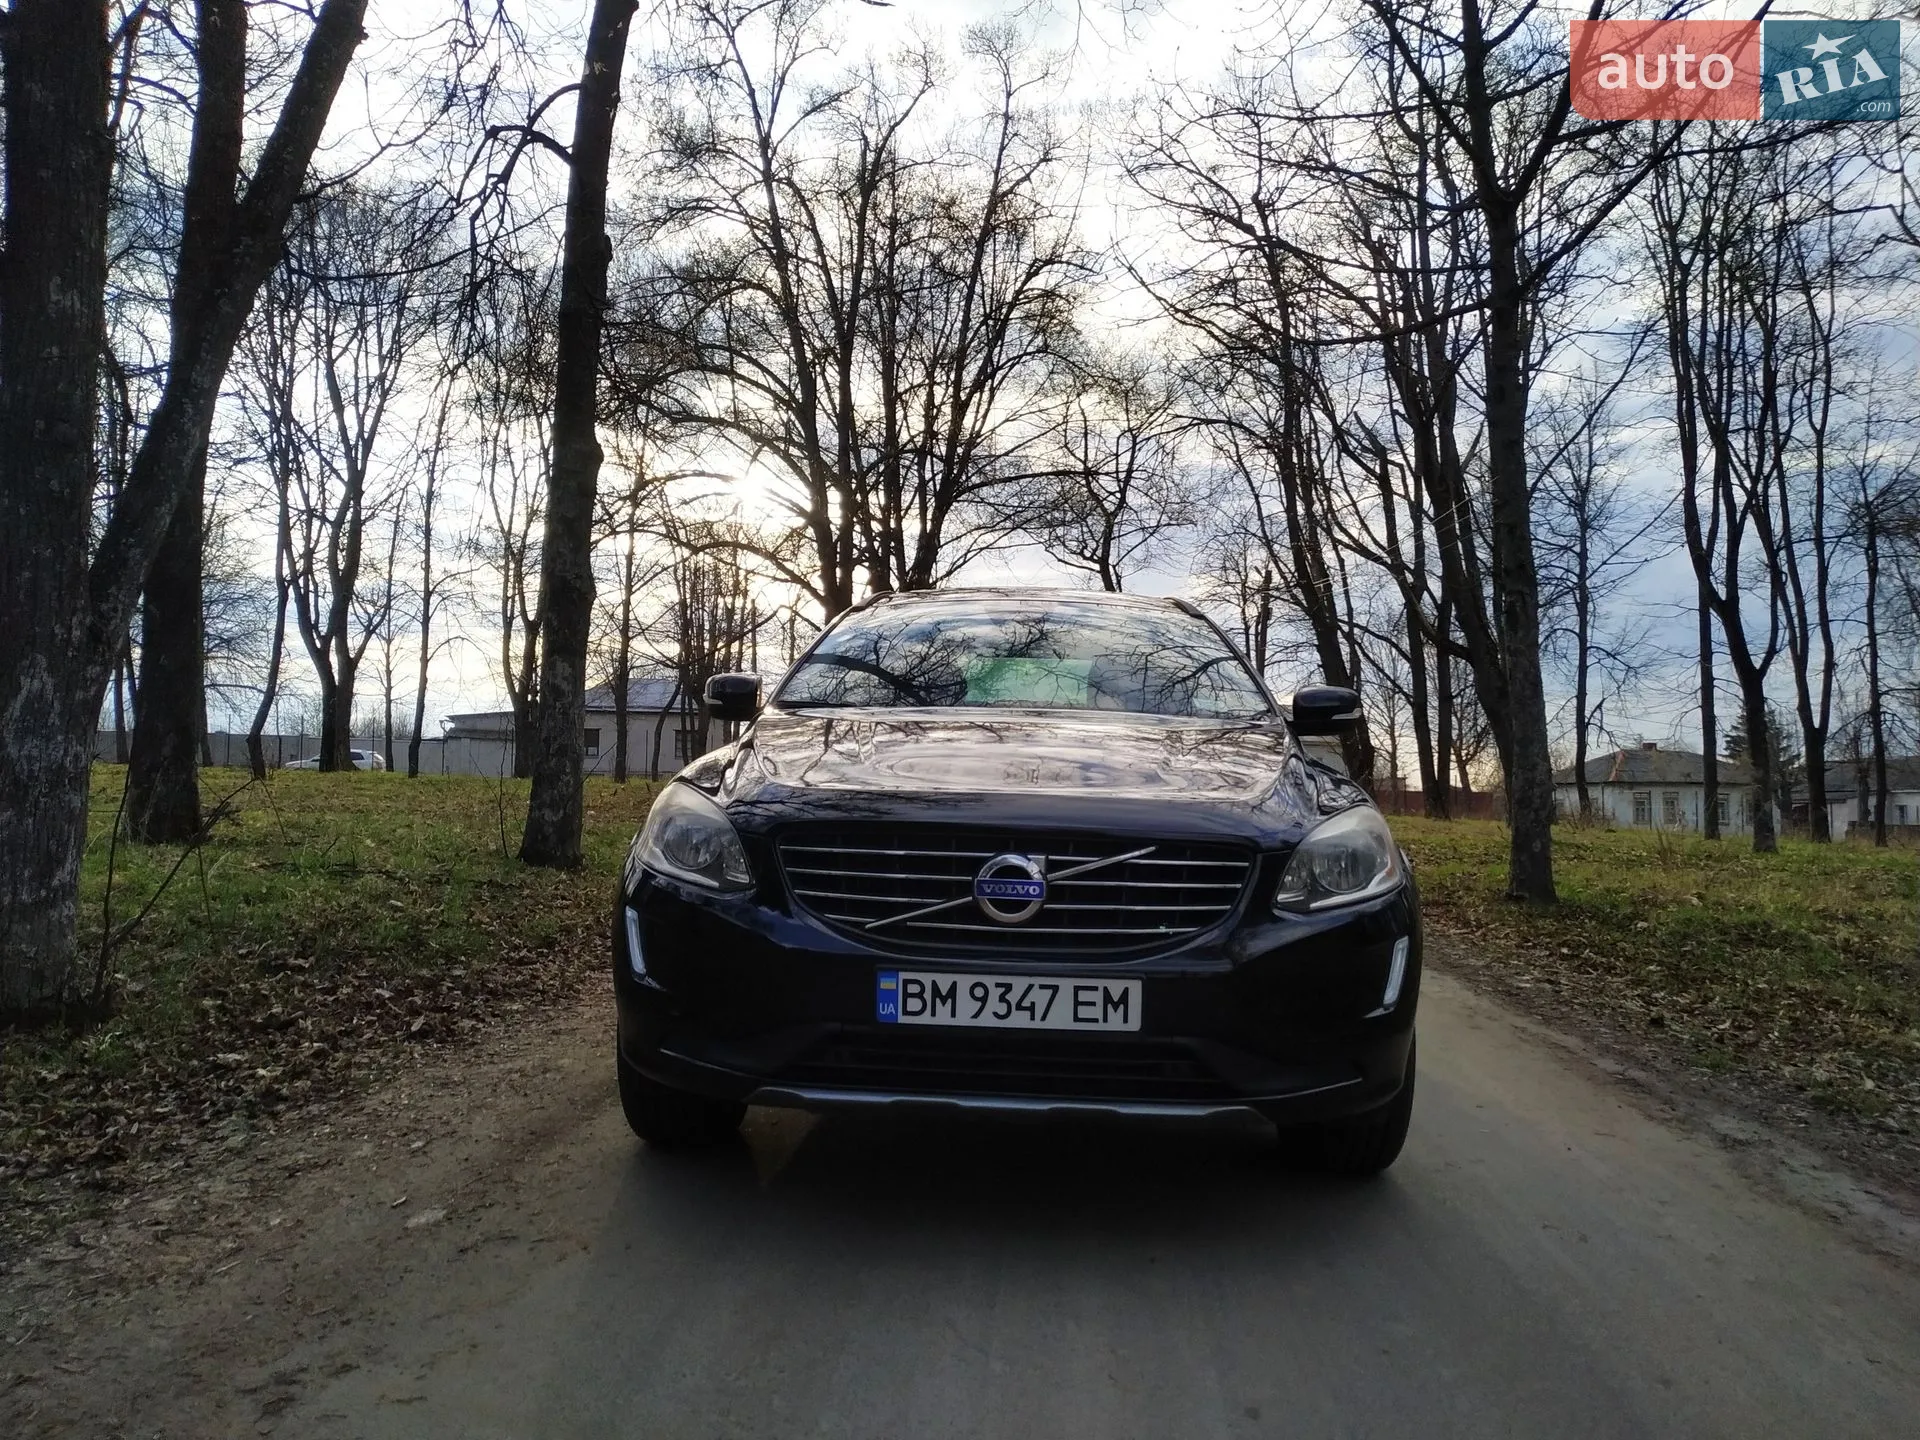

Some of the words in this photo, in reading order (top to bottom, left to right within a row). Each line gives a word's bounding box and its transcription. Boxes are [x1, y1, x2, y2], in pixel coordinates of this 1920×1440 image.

[980, 883, 1041, 896] VOLVO
[902, 978, 958, 1019] BM
[969, 981, 1060, 1022] 9347
[1073, 985, 1129, 1025] EM
[879, 1003, 896, 1015] UA
